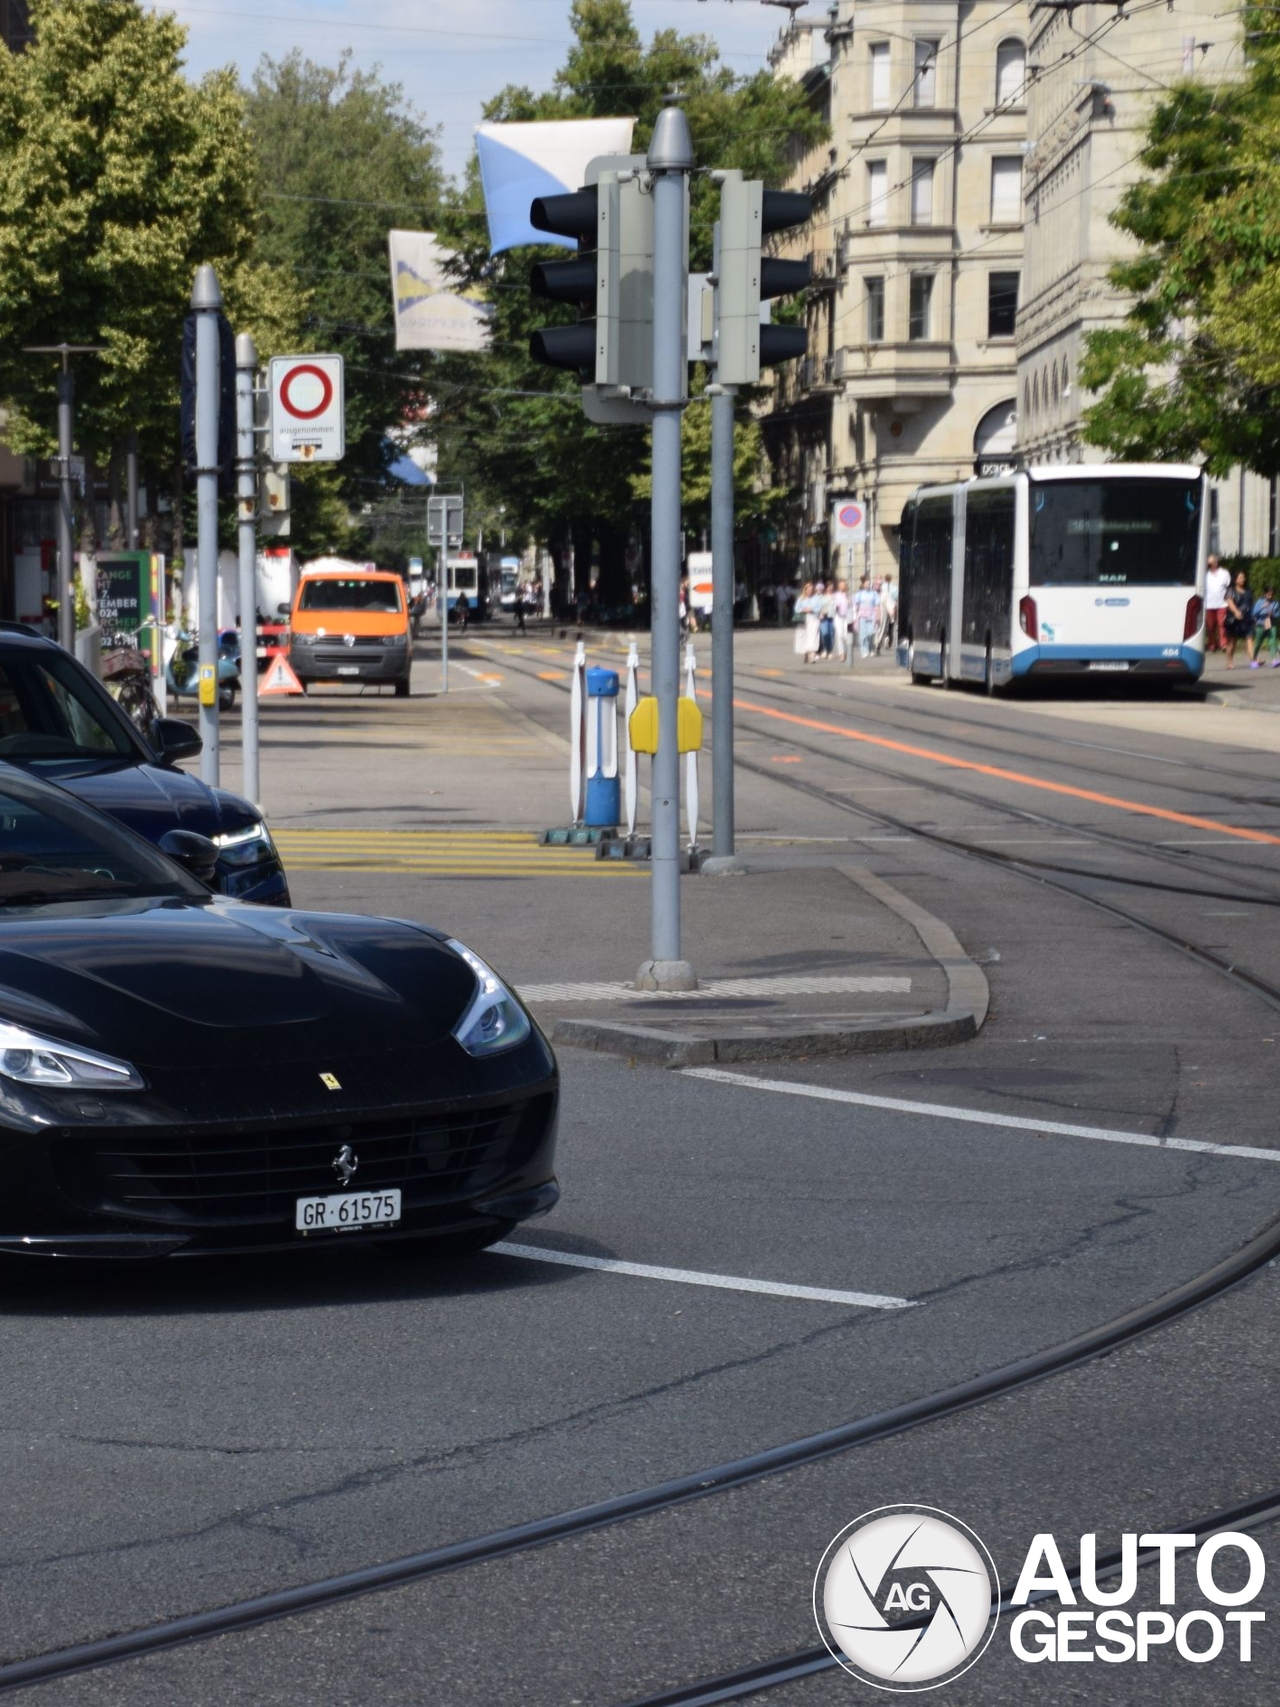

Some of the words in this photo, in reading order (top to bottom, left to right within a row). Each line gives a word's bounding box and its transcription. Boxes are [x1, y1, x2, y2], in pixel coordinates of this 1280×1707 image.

[280, 426, 334, 436] ausgenommen
[1099, 574, 1127, 582] MAN
[99, 598, 137, 608] EMBER
[100, 609, 118, 618] 024
[100, 618, 137, 627] RCHER
